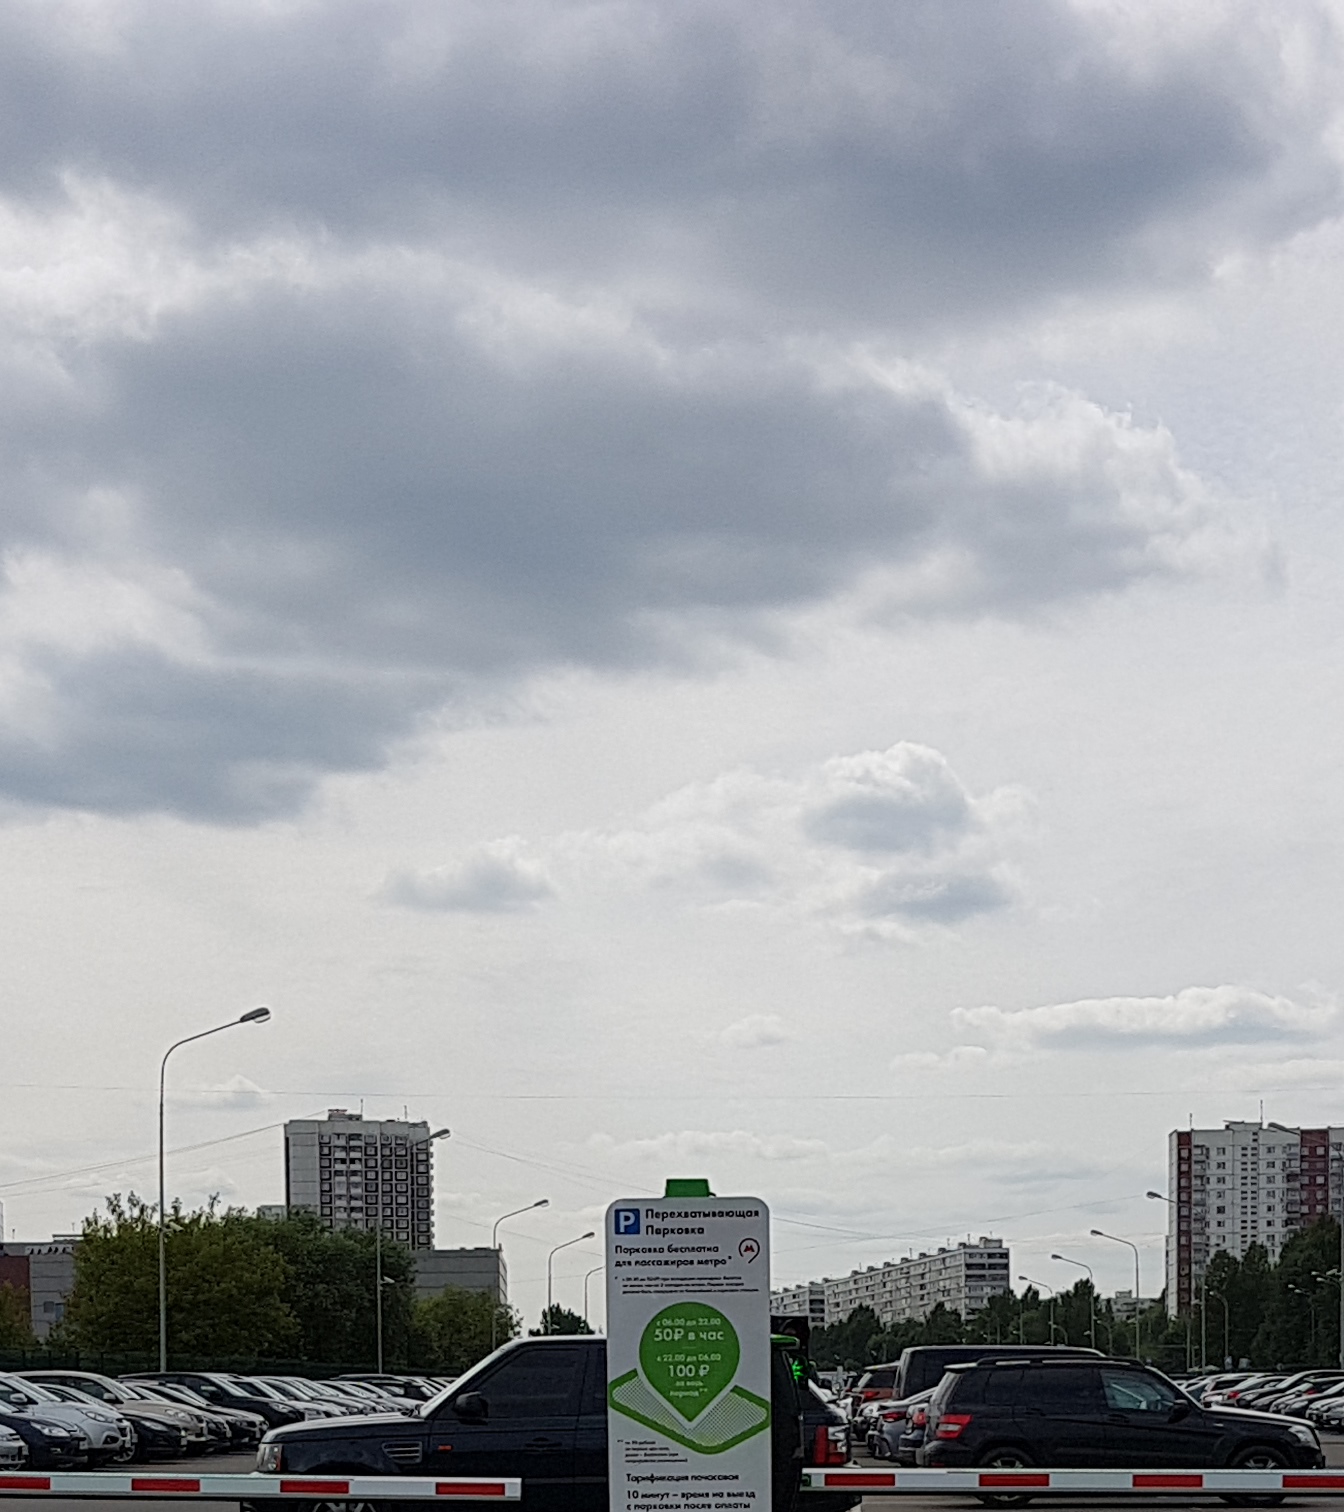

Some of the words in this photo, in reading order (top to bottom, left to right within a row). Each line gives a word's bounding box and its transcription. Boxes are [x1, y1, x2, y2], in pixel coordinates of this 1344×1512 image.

[645, 1209, 760, 1221] Перехватывающая
[619, 1211, 635, 1232] P
[645, 1225, 705, 1238] Парковка
[615, 1245, 665, 1257] Парковка
[634, 1258, 695, 1269] пассажиров
[699, 1331, 725, 1341] час
[669, 1364, 696, 1377] 100
[627, 1490, 639, 1499] 10
[640, 1492, 670, 1501] минут
[681, 1491, 710, 1501] время
[726, 1491, 756, 1500] выезд
[634, 1503, 681, 1512] парковки
[714, 1502, 751, 1510] оплаты
